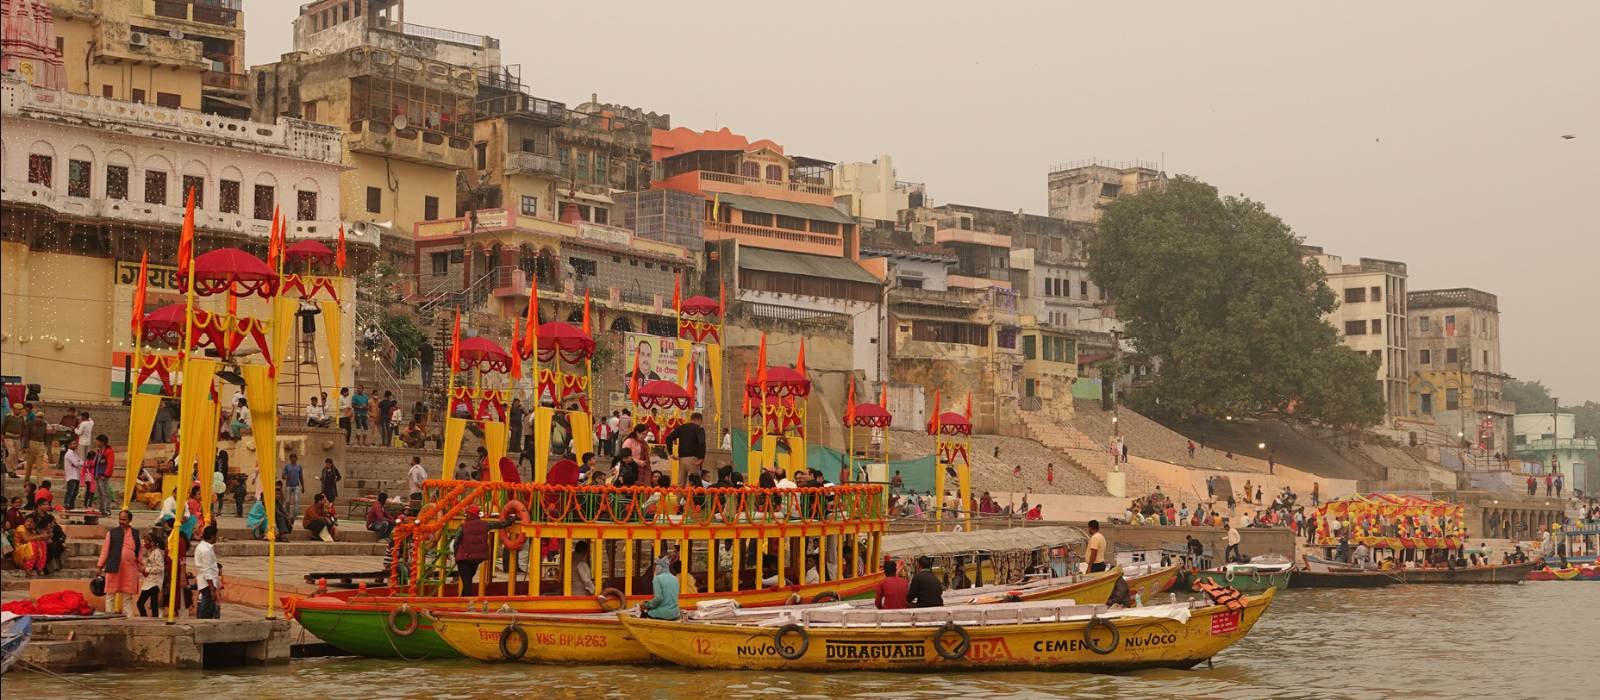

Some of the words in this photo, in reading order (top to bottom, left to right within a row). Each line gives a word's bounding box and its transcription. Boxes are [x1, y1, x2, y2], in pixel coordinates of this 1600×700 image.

[536, 633, 556, 645] VNS
[1125, 633, 1176, 647] NUVOCO
[696, 638, 712, 655] 12
[736, 643, 795, 656] NUVOO
[826, 645, 925, 658] DURAGUARD
[1034, 638, 1100, 652] CEMENT
